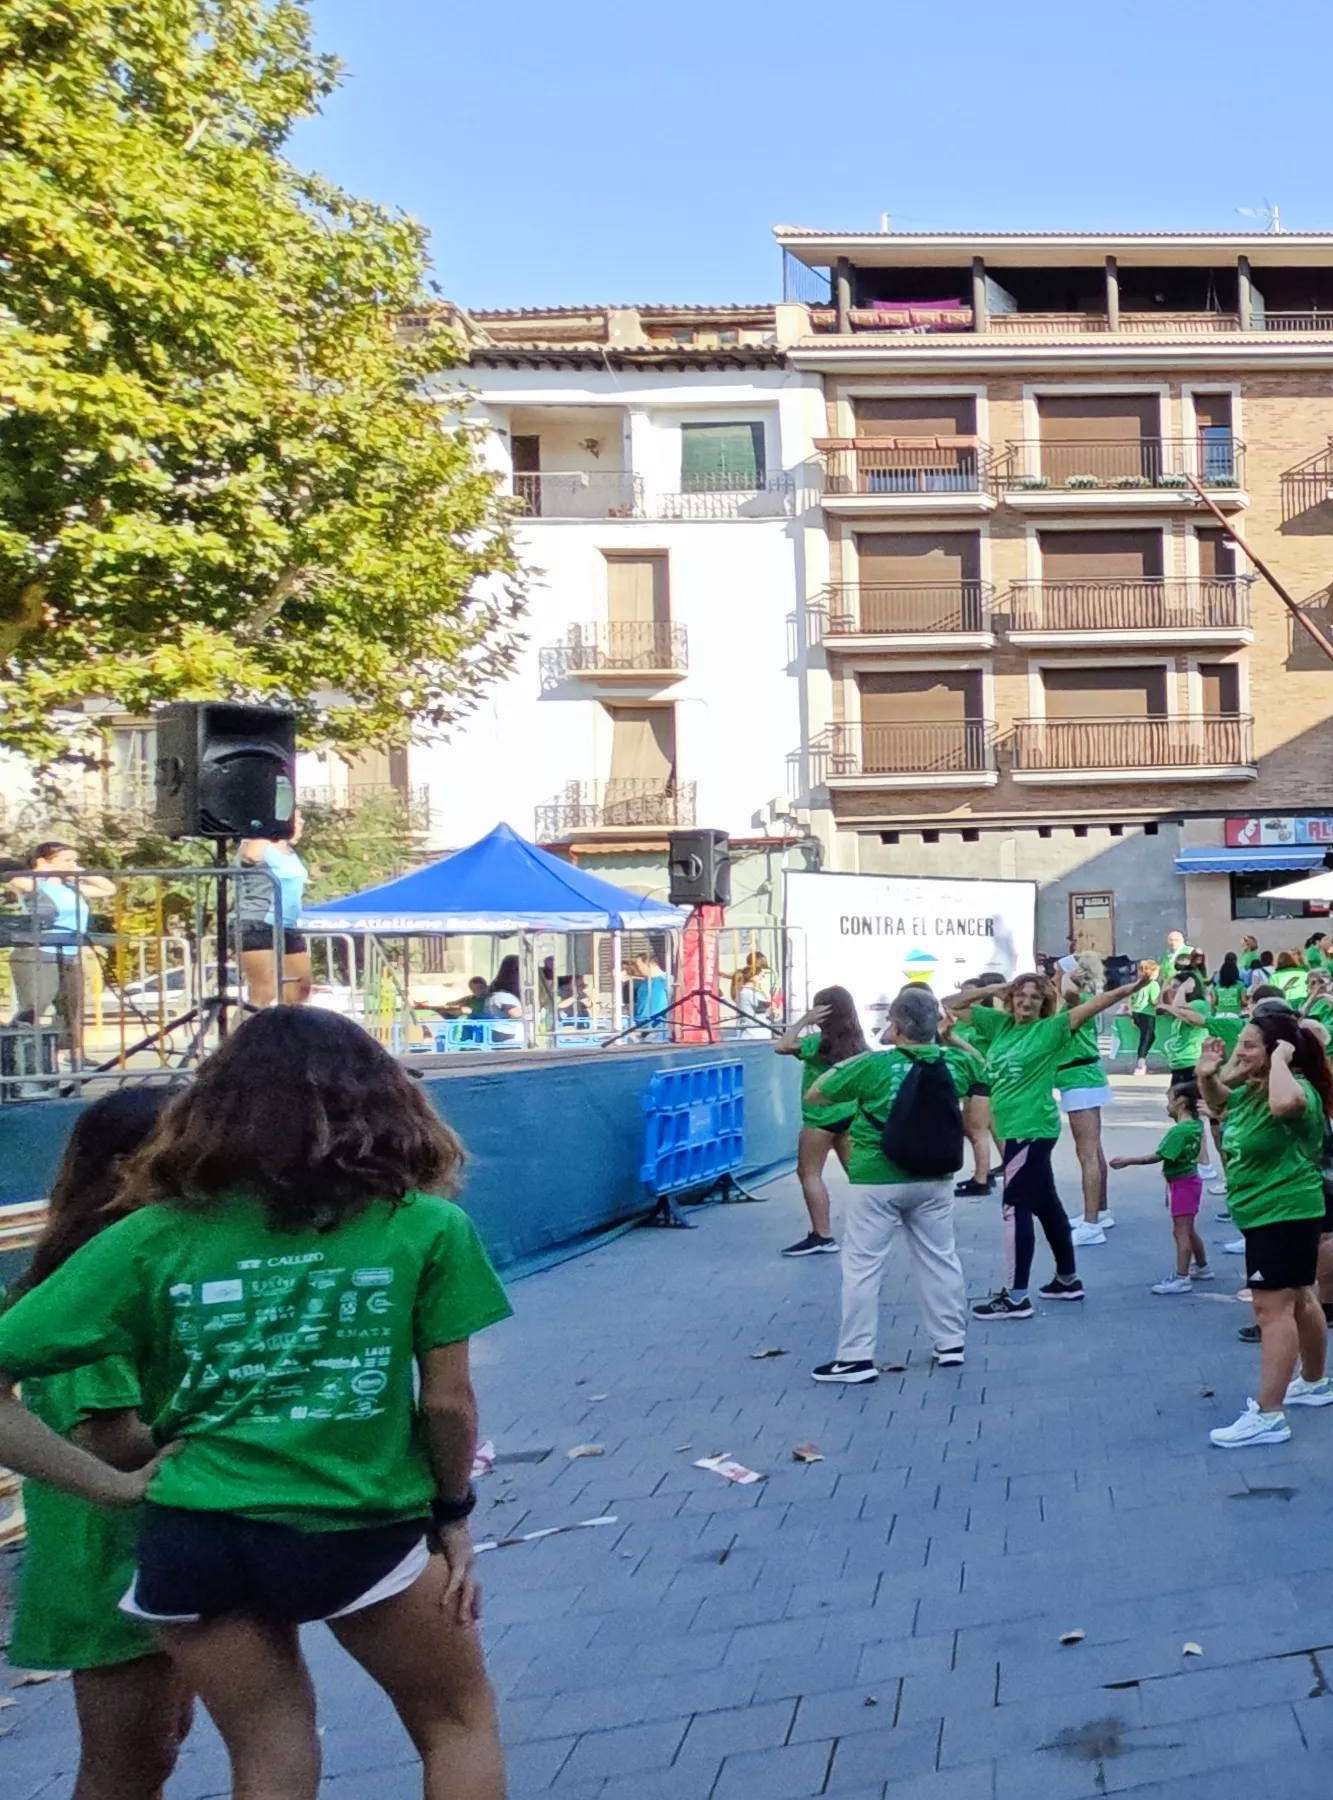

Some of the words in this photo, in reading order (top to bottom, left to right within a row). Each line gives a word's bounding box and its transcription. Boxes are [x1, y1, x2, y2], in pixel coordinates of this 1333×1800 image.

[840, 915, 906, 936] CONTRA
[912, 917, 927, 936] EL
[935, 917, 995, 937] CANCER
